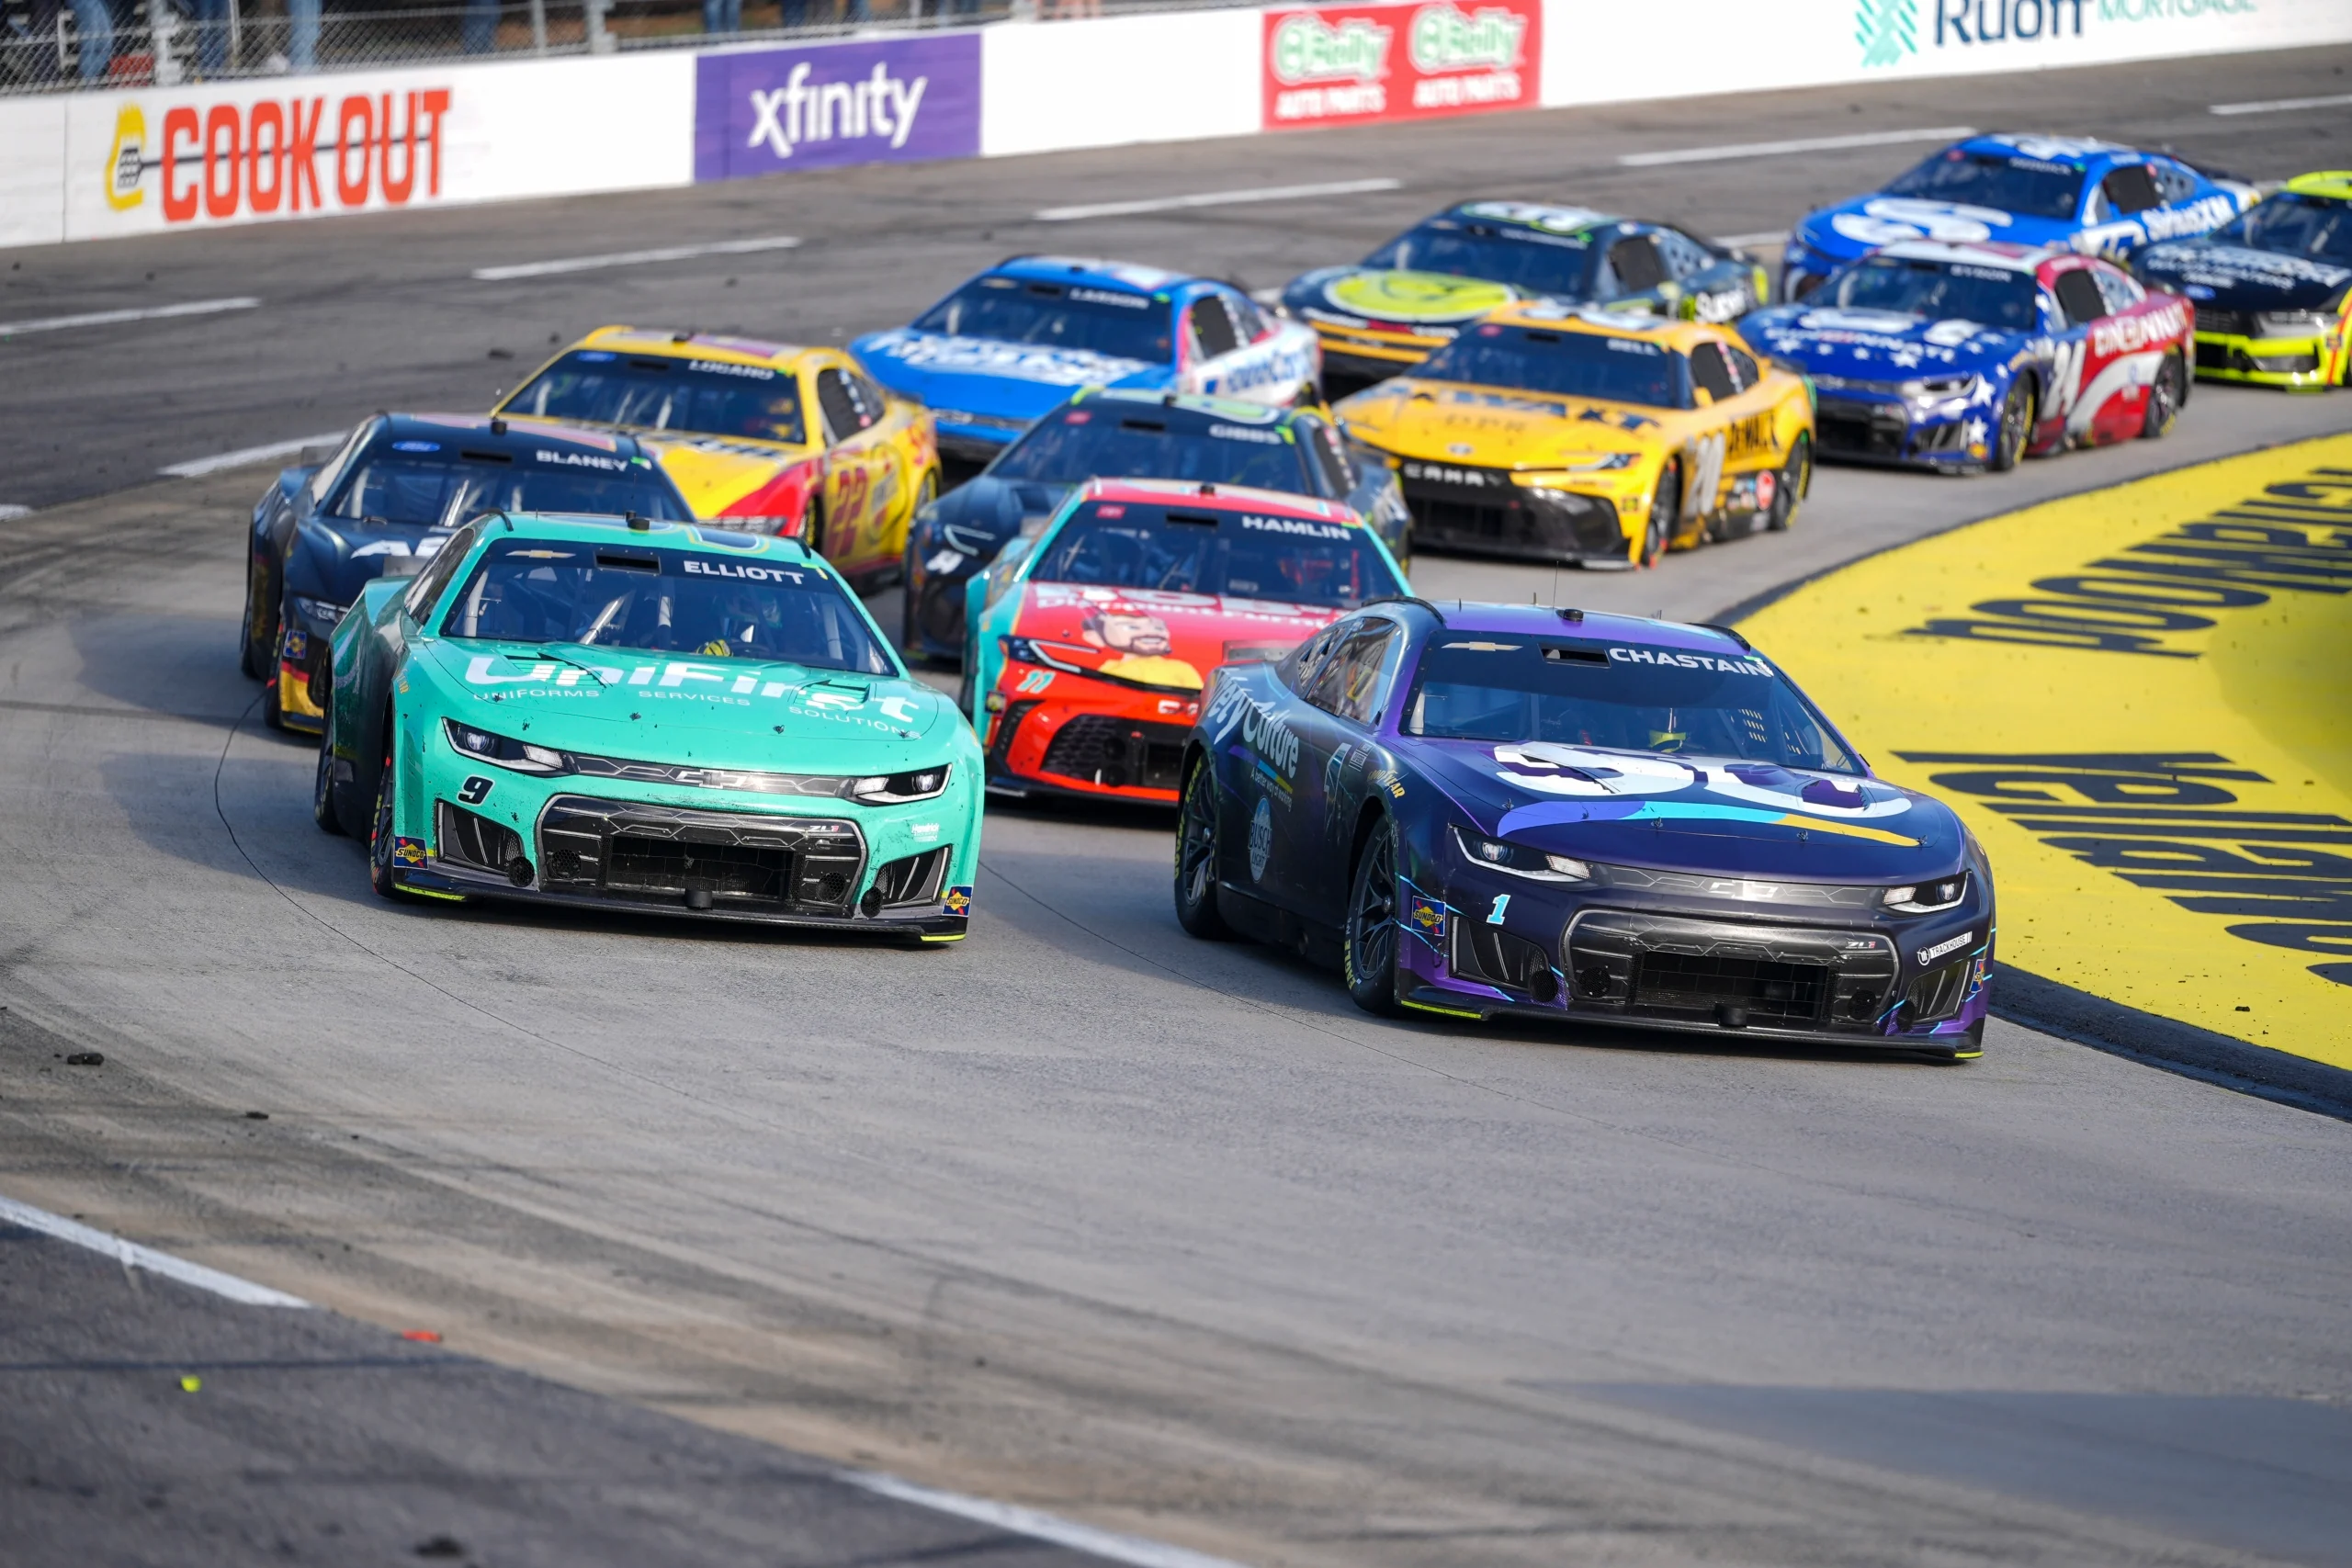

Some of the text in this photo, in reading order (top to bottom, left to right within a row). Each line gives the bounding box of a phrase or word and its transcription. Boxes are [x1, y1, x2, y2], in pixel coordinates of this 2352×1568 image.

[749, 62, 928, 159] xfinity
[161, 88, 451, 223] COOK OUT
[1068, 287, 1150, 310] LARSON
[687, 359, 775, 380] LOGANO
[1209, 423, 1282, 445] GIBBS
[536, 449, 628, 472] BLANEY
[1242, 515, 1352, 541] HAMLIN
[684, 560, 804, 585] ELLIOTT
[1610, 648, 1774, 678] CHASTAIN
[465, 656, 920, 724] UniFirst
[1015, 670, 1057, 694] 11
[473, 689, 600, 702] UNIFORMS
[639, 691, 751, 706] SERVICES
[788, 706, 922, 739] SOLUTIONS
[457, 774, 495, 807] 9
[1249, 821, 1272, 855] BUSCH
[397, 849, 425, 860] SUNOCO
[1888, 749, 2352, 987] YellaW
[946, 897, 969, 906] SUNOCO
[1486, 894, 1511, 926] 1
[1413, 910, 1442, 924] SUNOCO
[1931, 935, 1967, 957] TRACKHOUSE
